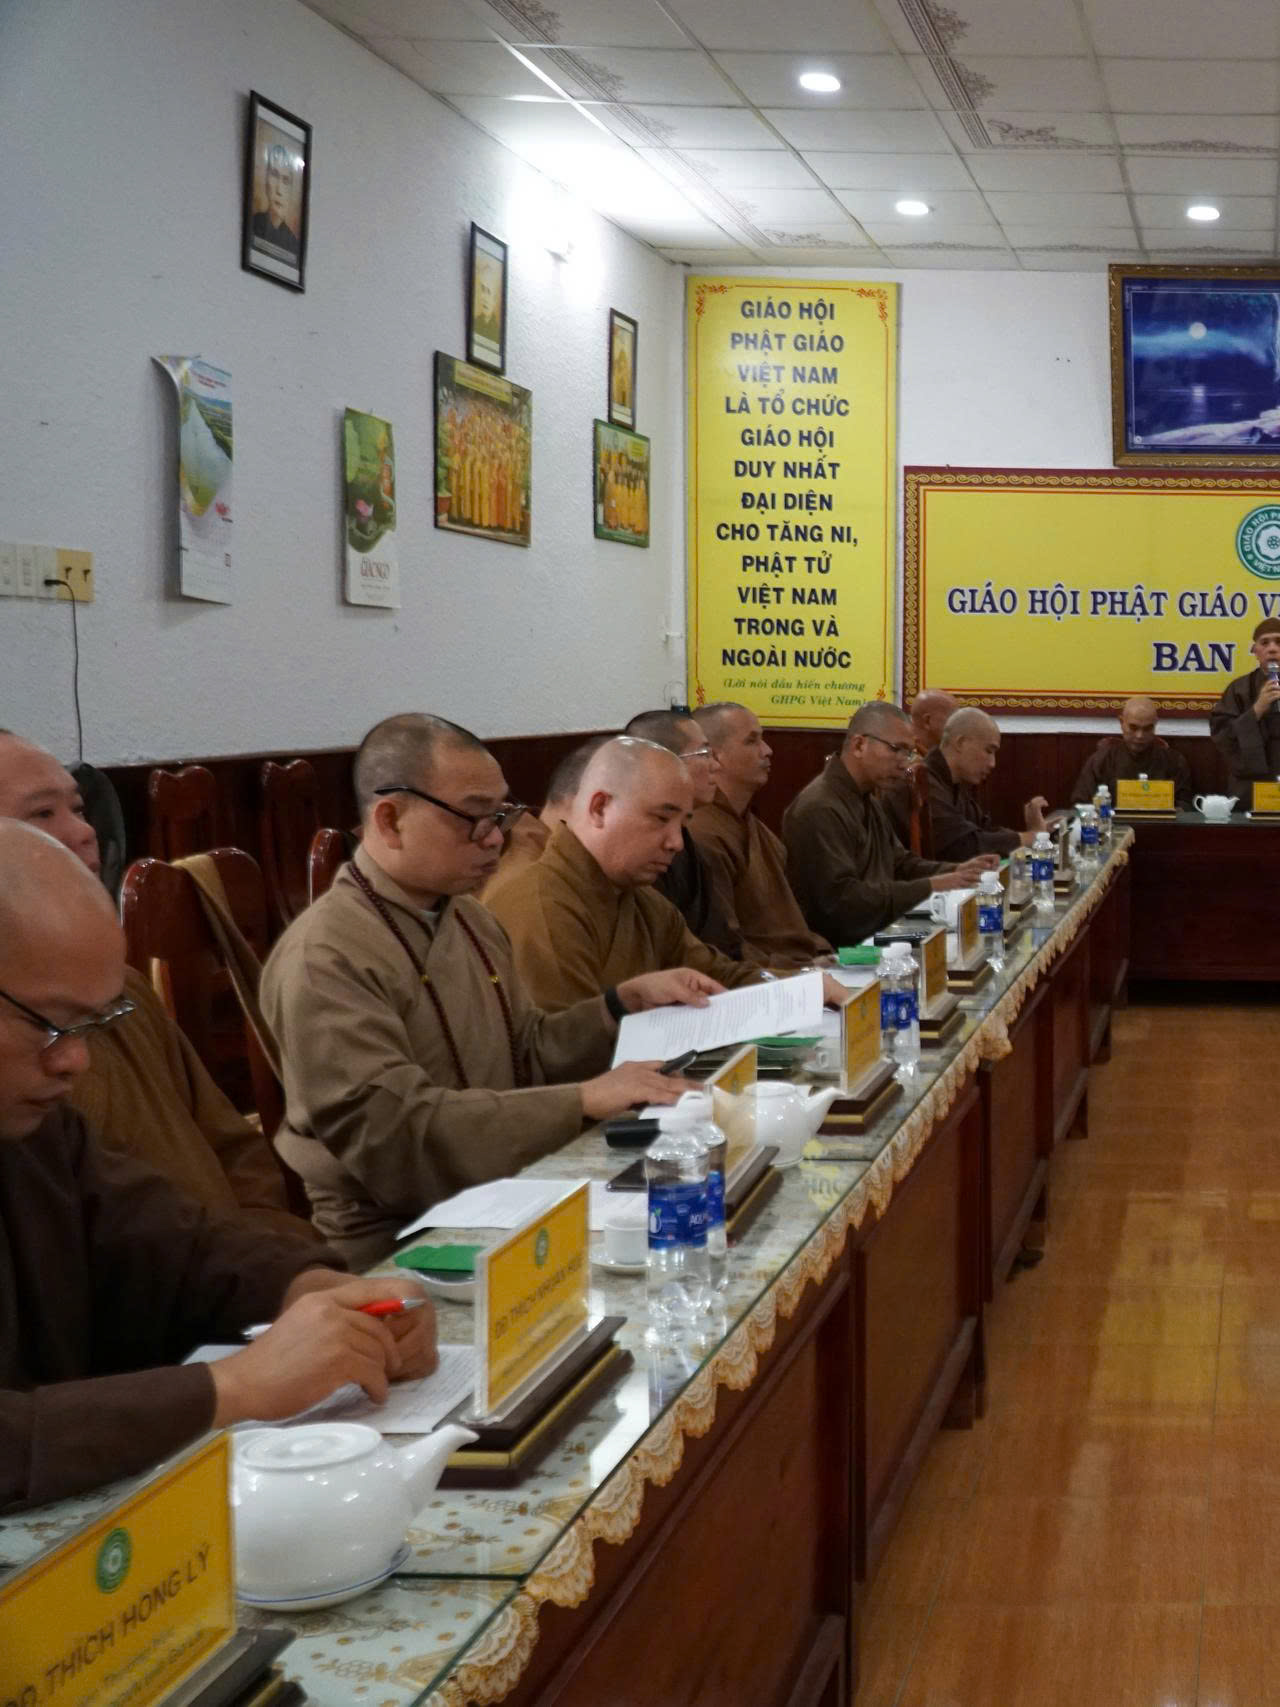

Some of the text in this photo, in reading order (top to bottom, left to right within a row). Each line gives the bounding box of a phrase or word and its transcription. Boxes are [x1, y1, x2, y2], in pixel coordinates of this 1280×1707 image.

[741, 296, 834, 324] GIÁO HỘI
[730, 330, 844, 355] PHẬT GIÁO
[737, 361, 837, 389] VIỆT NAM
[725, 386, 849, 416] LÀ TỔ CHỨC
[741, 425, 833, 451] GIÁO HỘI
[735, 452, 840, 479] DUY NHẤT
[741, 490, 832, 515] ĐẠI DIỆN
[716, 521, 857, 547] CHO TĂNG NI,
[742, 550, 832, 578] PHẬT TỬ
[738, 583, 836, 609] VIỆT NAM
[948, 582, 1017, 614] GIÁO
[1028, 583, 1080, 620] HỘI
[1091, 585, 1168, 622] PHẬT
[1179, 585, 1247, 617] GIÁO
[734, 615, 839, 637] TRONG VÀ
[722, 645, 851, 668] NGOÀI NƯỚC
[1152, 642, 1236, 672] BAN
